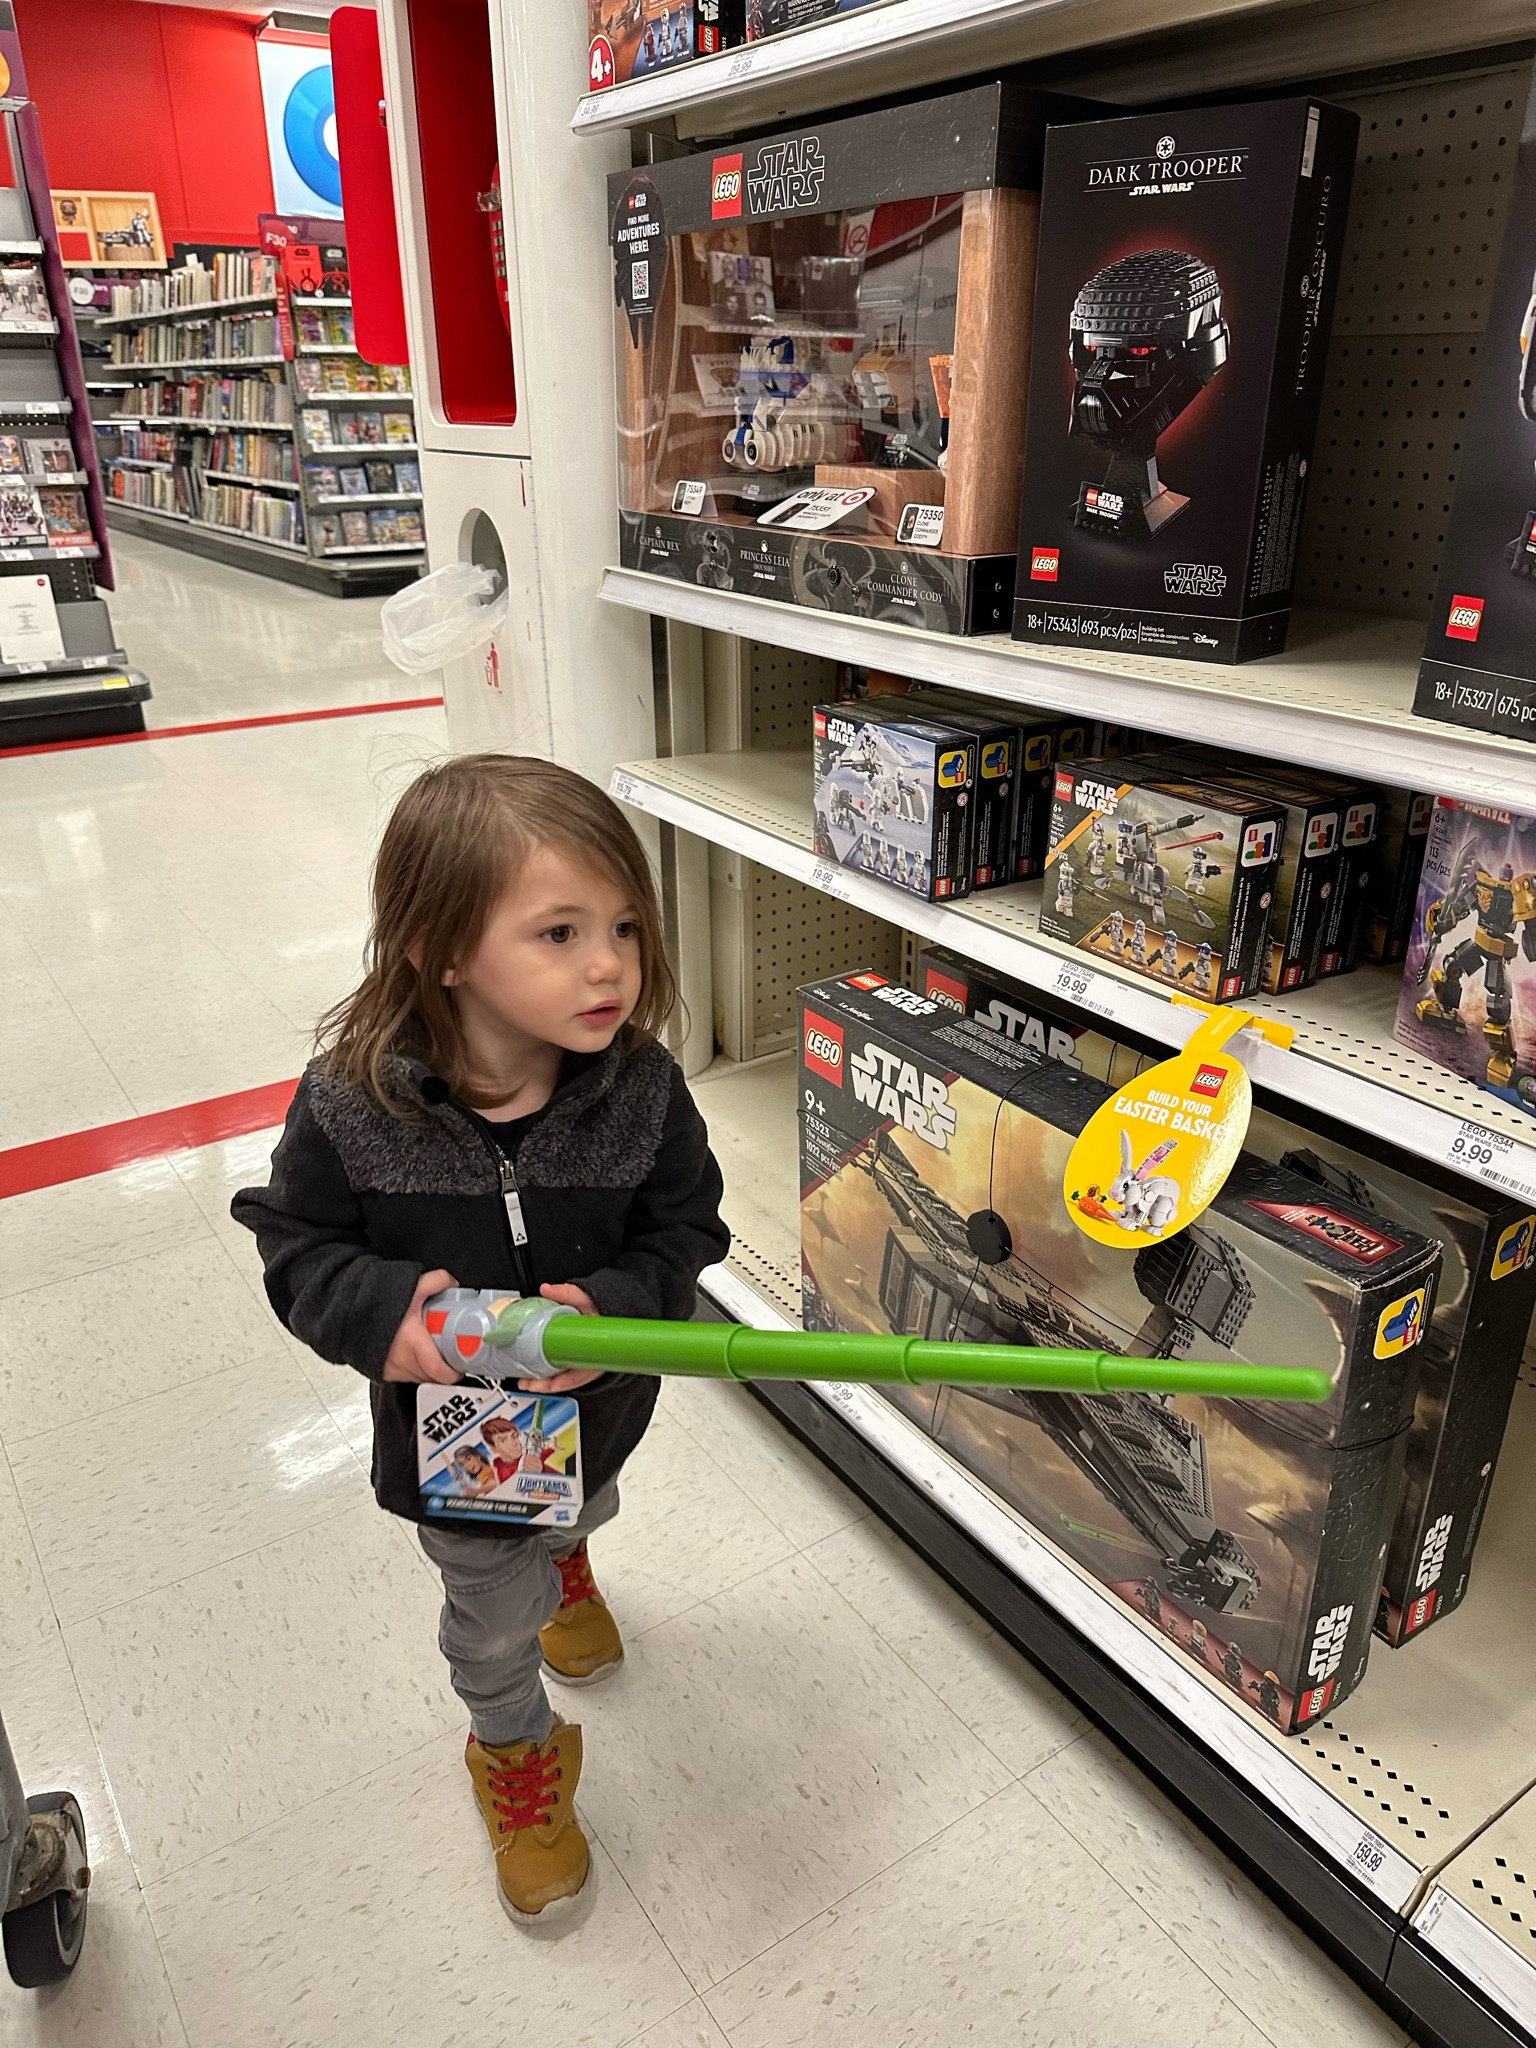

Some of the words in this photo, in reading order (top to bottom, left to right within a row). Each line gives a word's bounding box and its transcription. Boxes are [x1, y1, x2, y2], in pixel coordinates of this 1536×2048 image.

[704, 27, 713, 51] LEGO
[590, 47, 612, 82] 4+
[728, 61, 752, 77] 29.99
[747, 136, 825, 177] STAR
[1088, 163, 1141, 186] DARK
[714, 173, 741, 200] LEGO
[748, 171, 825, 214] WARS
[1128, 184, 1161, 197] STAR
[1162, 181, 1195, 194] WARS
[627, 217, 638, 226] FIND
[638, 214, 650, 224] MORE
[265, 232, 287, 247] F30
[617, 222, 660, 243] ADVENTURES
[629, 242, 650, 255] HERE!
[1317, 249, 1327, 287] WARS
[1295, 288, 1317, 396] TROOPER
[1311, 175, 1332, 278] OSCURO
[1313, 289, 1323, 327] STAR
[796, 491, 826, 502] only
[828, 491, 846, 502] at
[1097, 491, 1123, 504] STAR
[1098, 499, 1123, 512] WARS
[918, 509, 944, 521] 75350
[639, 535, 666, 549] CAPTAIN
[666, 541, 681, 552] REX
[740, 549, 772, 565] PRINCESS
[773, 554, 790, 568] LEIA
[1032, 556, 1059, 572] LEGO
[890, 573, 918, 587] CLONE
[1164, 562, 1226, 582] STAR
[867, 580, 918, 599] COMMANDER
[919, 590, 944, 603] CODY
[1164, 577, 1226, 597] WARS
[1027, 613, 1043, 630] 18+
[1047, 616, 1077, 633] 75343
[1081, 619, 1099, 635] 693
[1100, 622, 1138, 641] pcs/pzs
[1451, 609, 1480, 628] LEGO
[1192, 632, 1219, 648] Disney
[1434, 681, 1453, 701] 18+
[1457, 686, 1494, 710] 75327
[1497, 697, 1521, 717] 675
[827, 718, 856, 737] STAR
[827, 729, 856, 748] WARS
[616, 782, 632, 795] 15.79
[1056, 780, 1071, 794] LEGO
[1075, 779, 1119, 803] STAR
[1053, 803, 1062, 813] 6+
[1075, 790, 1118, 815] WARS
[1434, 813, 1446, 824] 6+
[1429, 845, 1439, 859] 113
[811, 867, 834, 884] 19.99
[1426, 859, 1452, 877] pcs/pzs
[1062, 961, 1079, 972] LEGO
[1079, 967, 1096, 979] 75345
[1326, 954, 1334, 971] LEGO
[1056, 973, 1087, 995] 19.99
[1227, 979, 1236, 996] LEGO
[1287, 968, 1296, 985] LEGO
[871, 988, 932, 1016] WARS
[880, 986, 939, 1013] STAR
[974, 999, 1083, 1071] STAR
[805, 1028, 842, 1068] LEGO
[850, 1041, 957, 1117] STAR
[1195, 1073, 1223, 1088] LEGO
[804, 1089, 826, 1116] 9+
[850, 1065, 956, 1150] WARS
[1113, 1096, 1168, 1127] EASTER
[1147, 1089, 1180, 1109] BUILD
[1181, 1098, 1213, 1118] YOUR
[805, 1112, 830, 1138] 75323
[805, 1127, 816, 1139] The
[1461, 1121, 1487, 1138] LEGO
[1489, 1132, 1515, 1149] 75344
[1457, 1129, 1475, 1141] STAR
[1475, 1136, 1492, 1149] WARS
[806, 1139, 820, 1158] 1022
[820, 1153, 841, 1172] pcs/pzs
[1451, 1137, 1493, 1165] 9.99
[1515, 1227, 1530, 1251] LIFE
[1406, 1302, 1418, 1328] LIFE
[1406, 1327, 1414, 1343] LEGO
[825, 1380, 853, 1401] 9.99
[422, 1394, 471, 1436] STAR
[427, 1400, 478, 1443] WARS
[1415, 1516, 1441, 1593] STAR
[1427, 1513, 1454, 1589] WARS
[1453, 1573, 1467, 1603] Disney
[1413, 1597, 1428, 1627] LEGO
[1308, 1606, 1338, 1683] STAR
[1324, 1603, 1354, 1680] WARS
[1351, 1656, 1365, 1686] Disney
[1308, 1686, 1326, 1716] LEGO
[1353, 1840, 1383, 1872] 159.99
